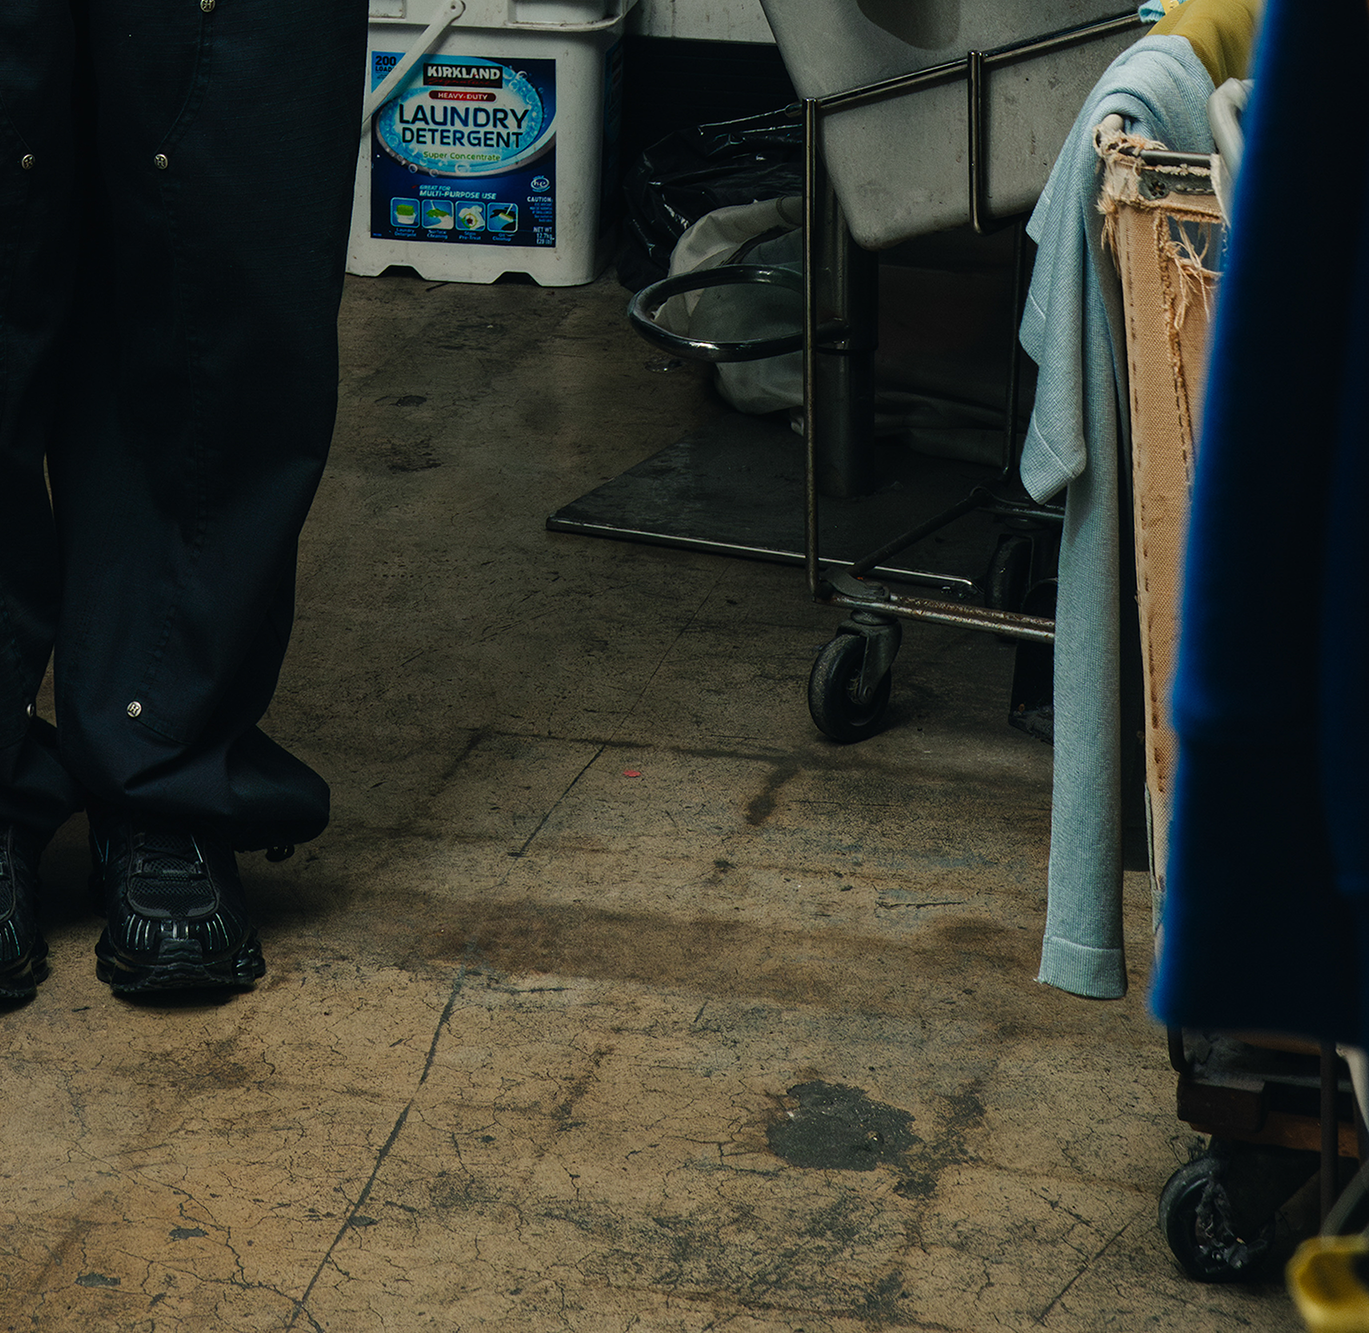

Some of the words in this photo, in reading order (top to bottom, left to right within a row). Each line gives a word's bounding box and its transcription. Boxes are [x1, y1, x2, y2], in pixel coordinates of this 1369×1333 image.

[375, 55, 397, 66] 200
[427, 66, 501, 80] KIRKLAND
[438, 92, 488, 101] HEAVY-DUTY
[399, 103, 530, 130] LAUNDRY
[402, 127, 524, 149] DETERGENT
[423, 151, 448, 160] Super
[450, 152, 501, 162] Concentrate
[419, 190, 480, 200] MULTI-PURPOSE
[481, 192, 497, 200] USE
